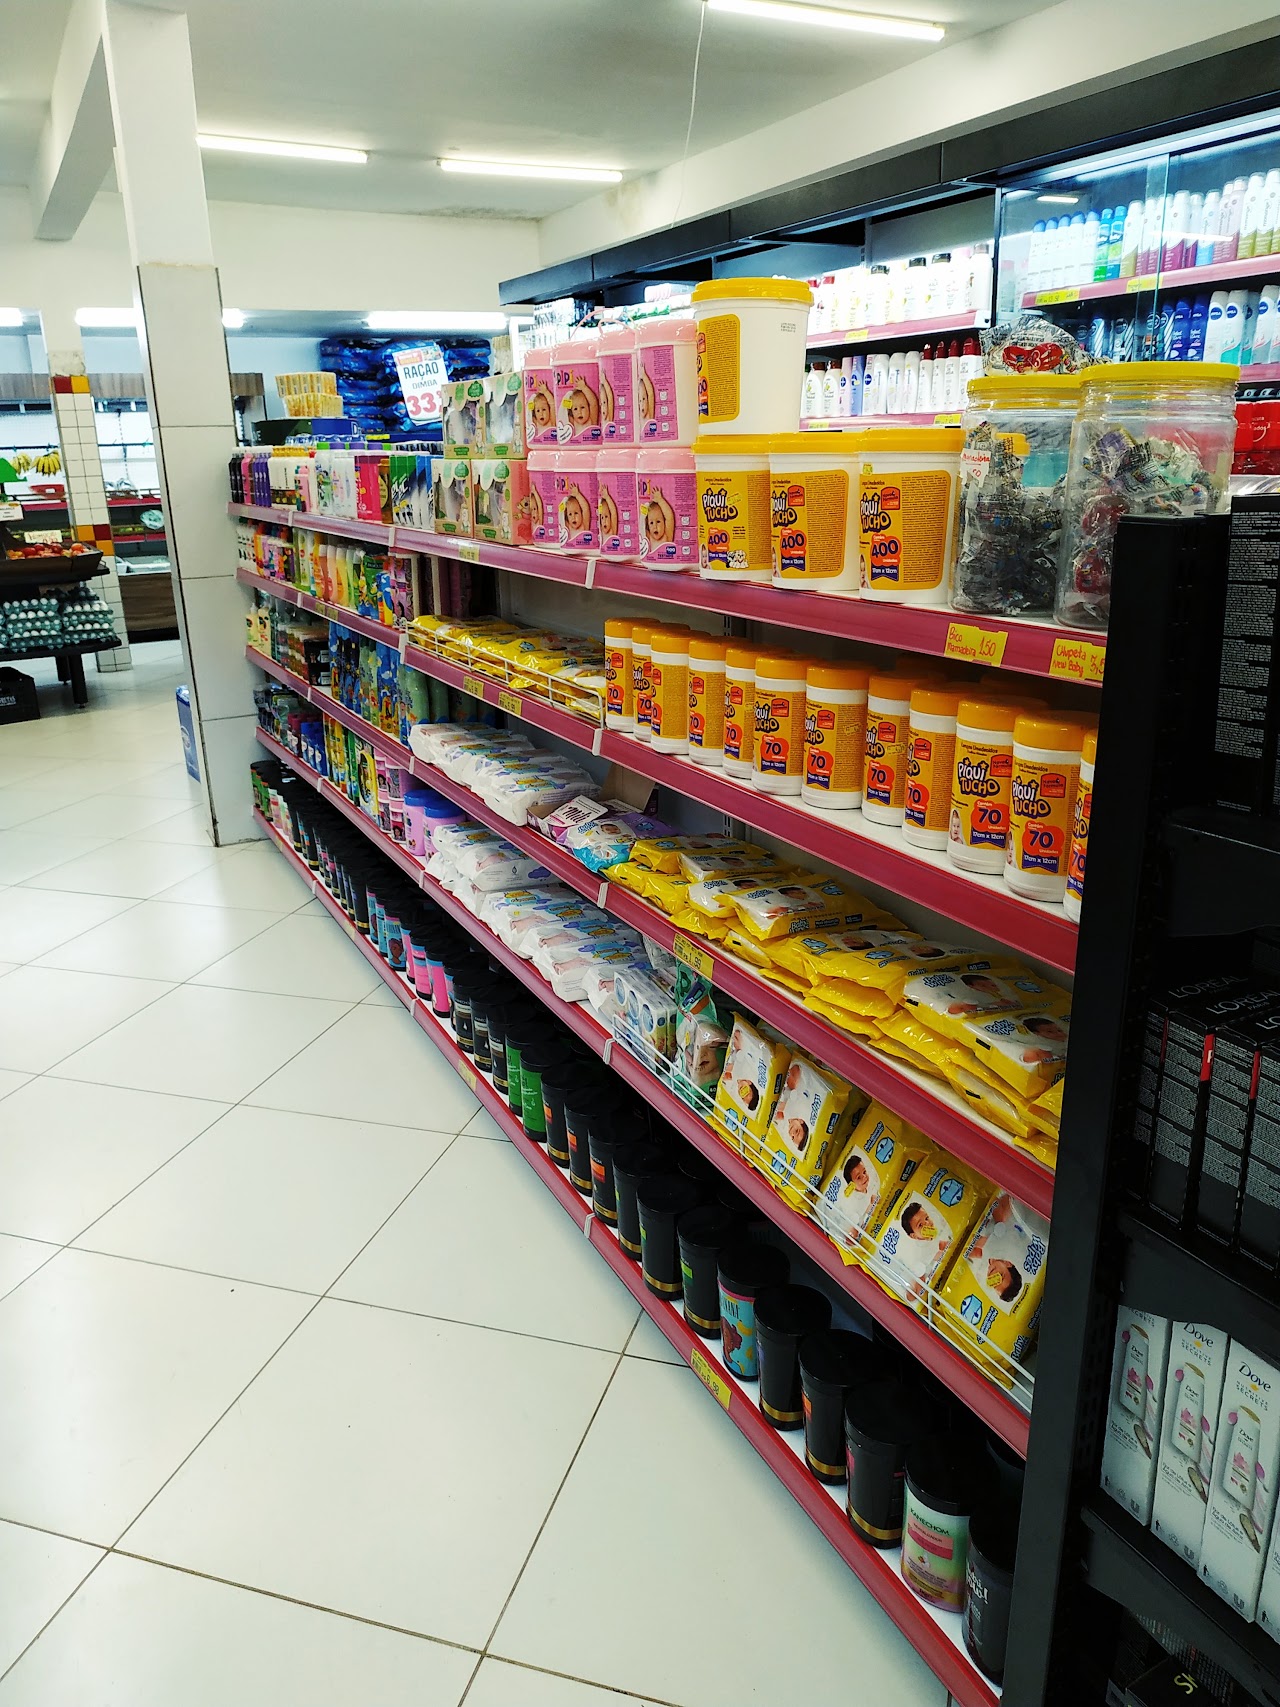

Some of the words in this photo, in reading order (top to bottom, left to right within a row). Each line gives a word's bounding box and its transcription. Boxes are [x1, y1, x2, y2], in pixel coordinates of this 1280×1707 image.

[702, 488, 727, 508] PIQUI
[705, 505, 737, 520] TUCHO
[708, 533, 728, 545] 400
[782, 533, 804, 549] 400
[872, 540, 898, 558] 400
[949, 627, 962, 642] Bico
[1068, 662, 1084, 678] Baby
[726, 727, 737, 740] 70
[765, 742, 781, 755] 70
[811, 754, 826, 768] 70
[958, 757, 988, 780] PIQUI
[871, 769, 886, 783] 70
[908, 787, 921, 803] 70
[960, 779, 999, 795] TUCHO
[1012, 776, 1039, 800] PIQUI
[1013, 798, 1051, 817] TUCHO
[978, 808, 1002, 824] 70
[973, 831, 984, 839] 17cm
[1029, 830, 1053, 848] 70
[1248, 1002, 1270, 1010] PARIS
[1183, 1322, 1214, 1348] Dove
[1181, 1342, 1212, 1366] SECRETS
[1239, 1361, 1271, 1392] Dove
[1236, 1384, 1268, 1411] SECRETS
